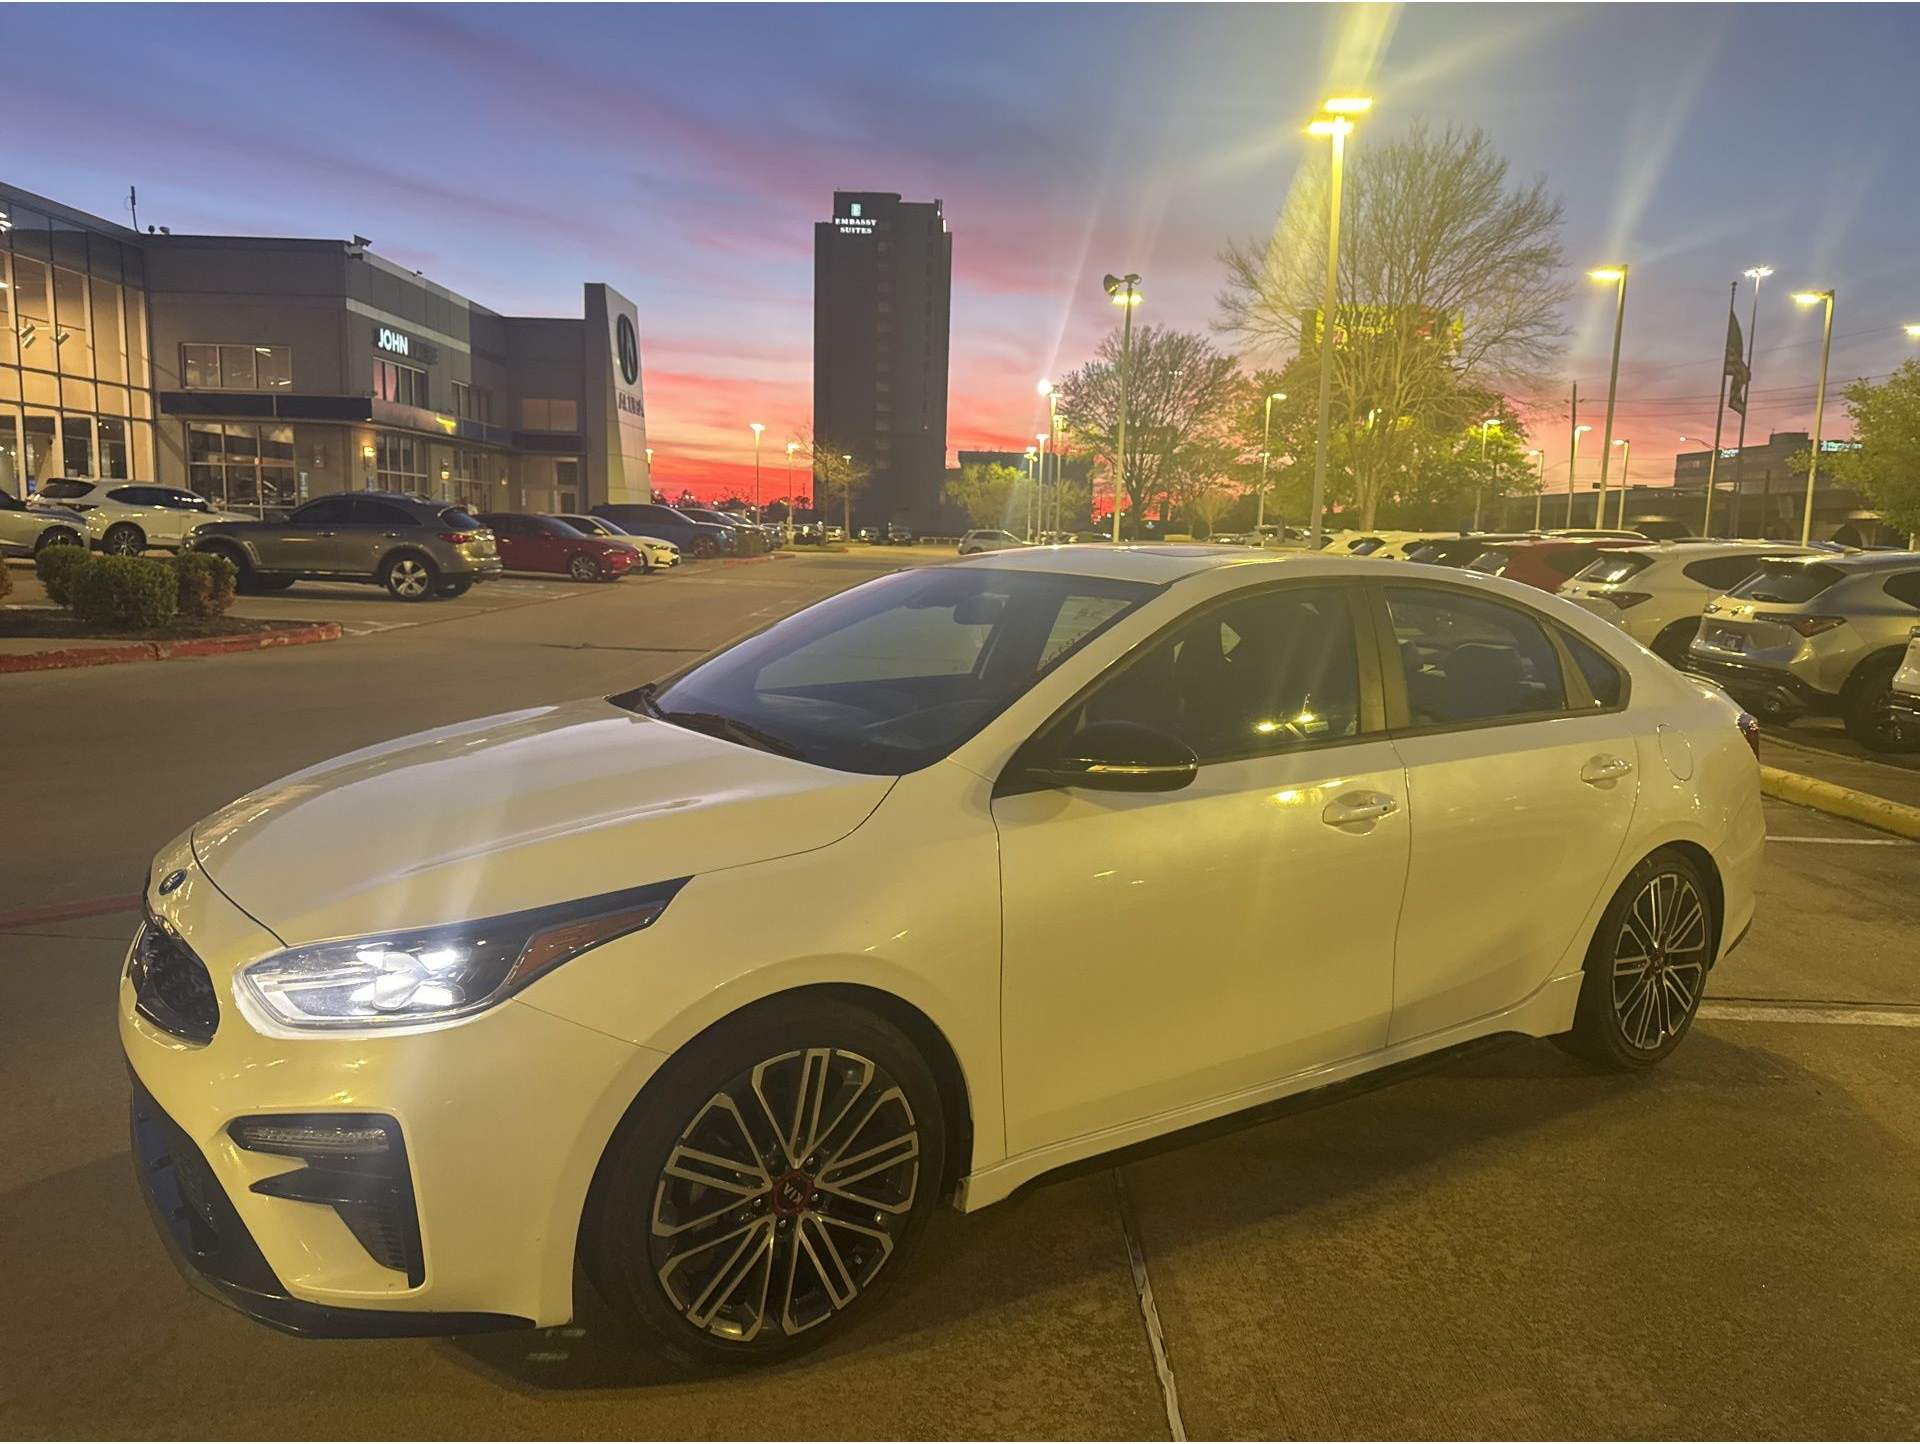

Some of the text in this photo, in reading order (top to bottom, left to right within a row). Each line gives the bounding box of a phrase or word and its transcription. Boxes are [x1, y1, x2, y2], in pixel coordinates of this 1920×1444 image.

[835, 217, 877, 226] EMBASSY
[840, 226, 872, 234] SUITES
[378, 328, 409, 356] JOHN
